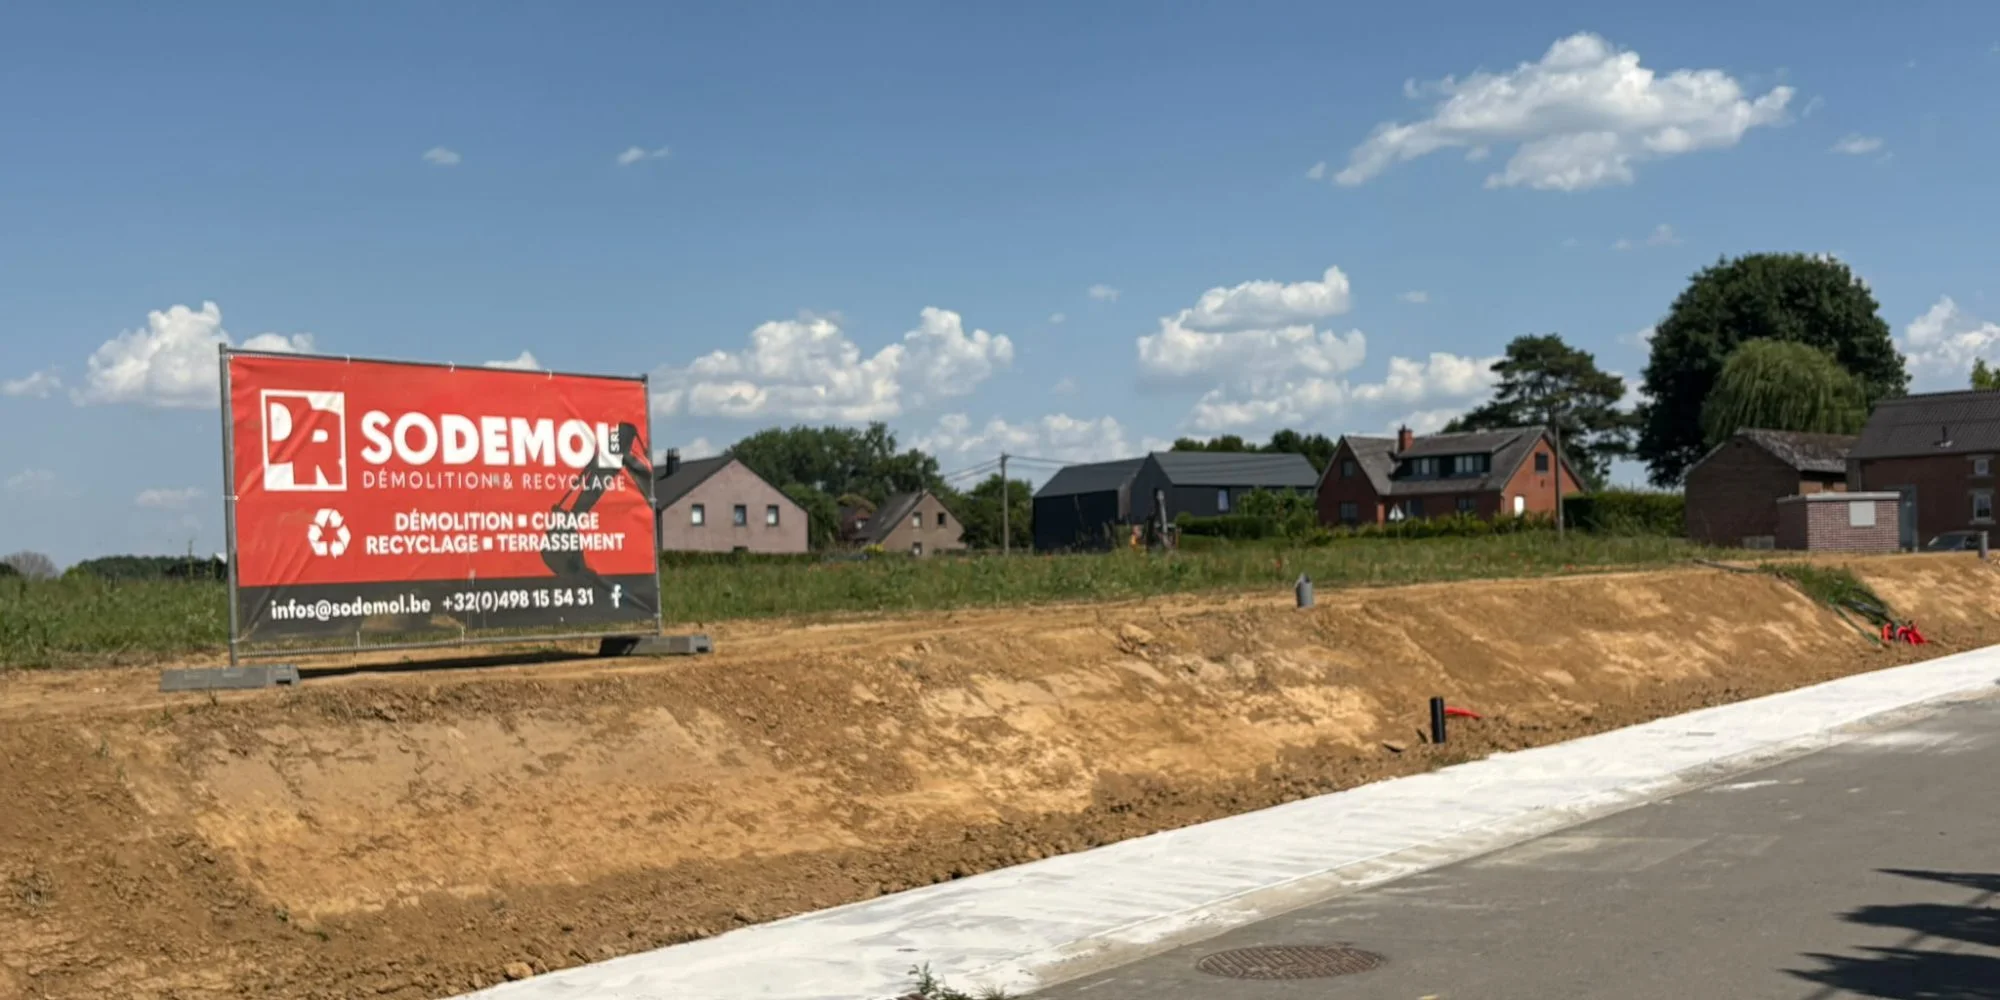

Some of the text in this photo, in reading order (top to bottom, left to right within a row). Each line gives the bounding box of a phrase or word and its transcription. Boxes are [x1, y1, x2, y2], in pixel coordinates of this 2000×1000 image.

[361, 410, 623, 468] SODEMOL
[610, 423, 620, 452] SRL
[363, 468, 626, 491] DÉMOLITION & RECYCLAGE
[395, 508, 599, 531] DÉMOLITION CURAGE
[366, 533, 625, 555] RECYCLAGE TERRASSEMENT
[271, 588, 594, 621] infos@sodemol.be +32(0)498 15 54 31
